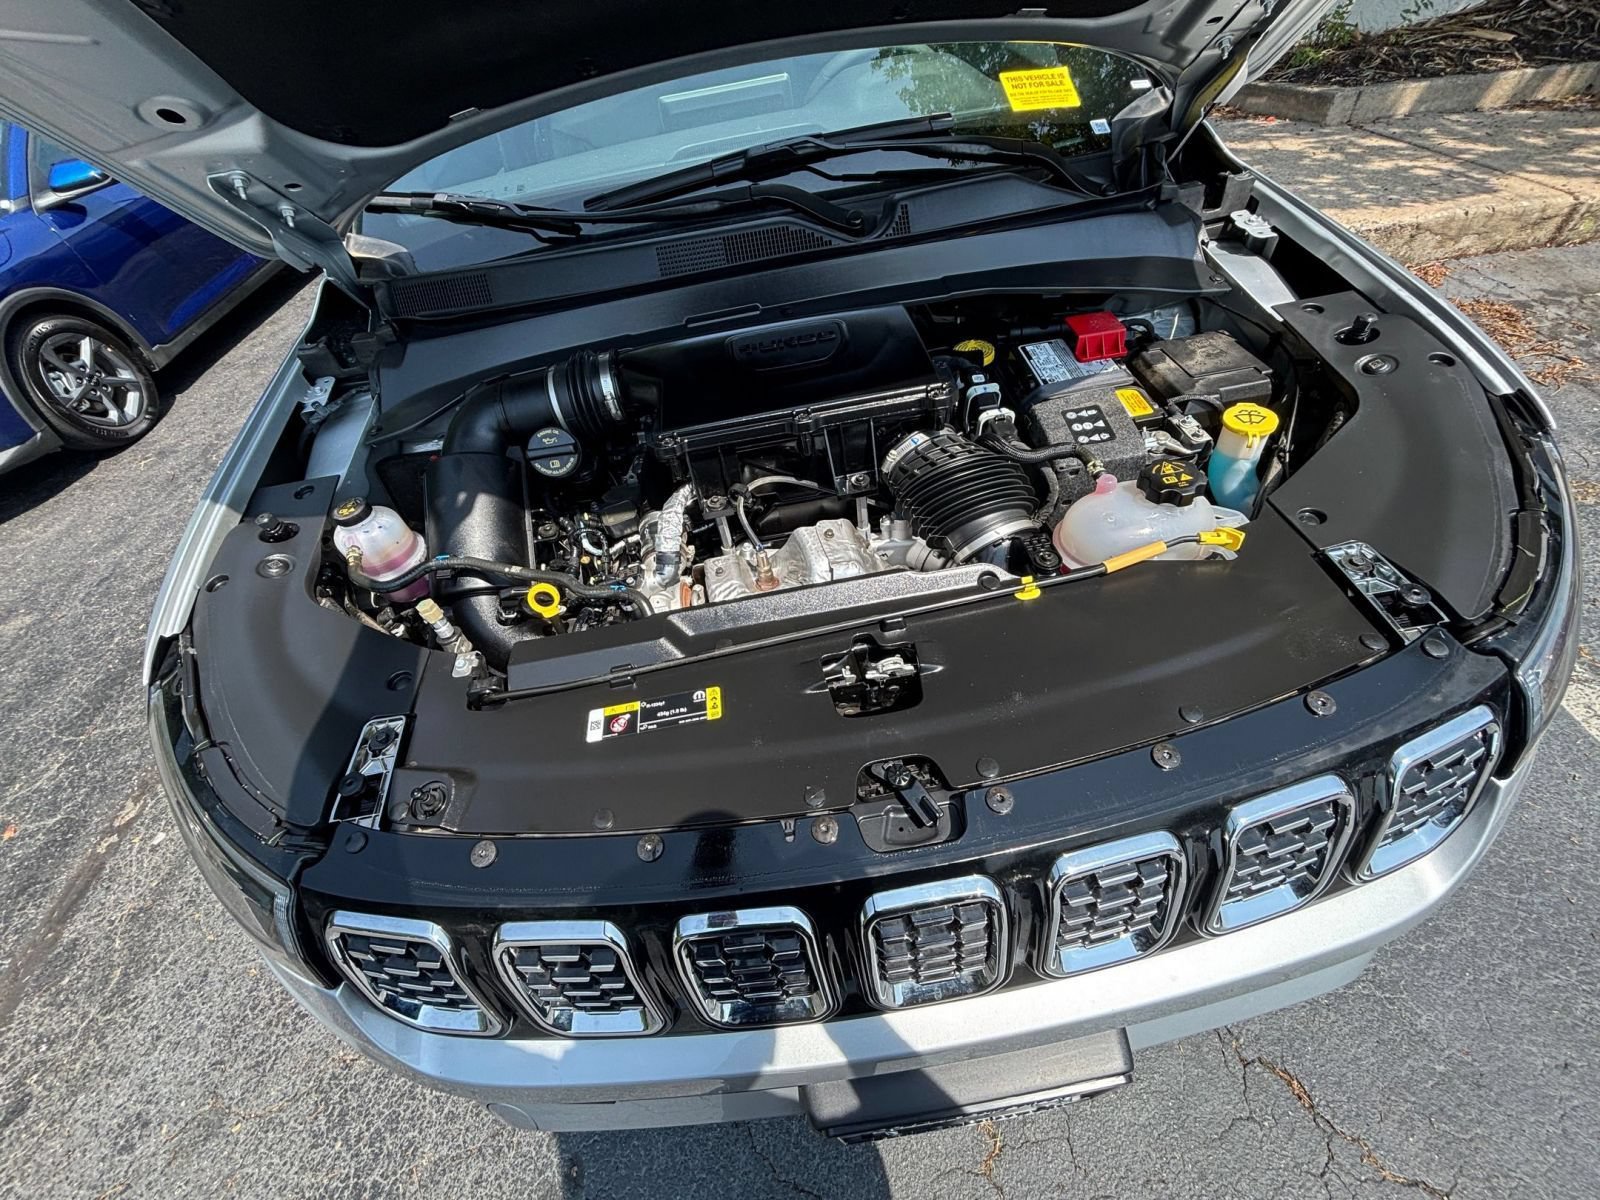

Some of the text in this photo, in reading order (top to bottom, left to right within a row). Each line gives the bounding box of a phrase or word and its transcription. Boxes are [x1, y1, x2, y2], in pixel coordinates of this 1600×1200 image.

[1005, 75, 1024, 83] THIS
[1023, 73, 1056, 81] VEHICLE
[537, 429, 552, 438] ENGINE
